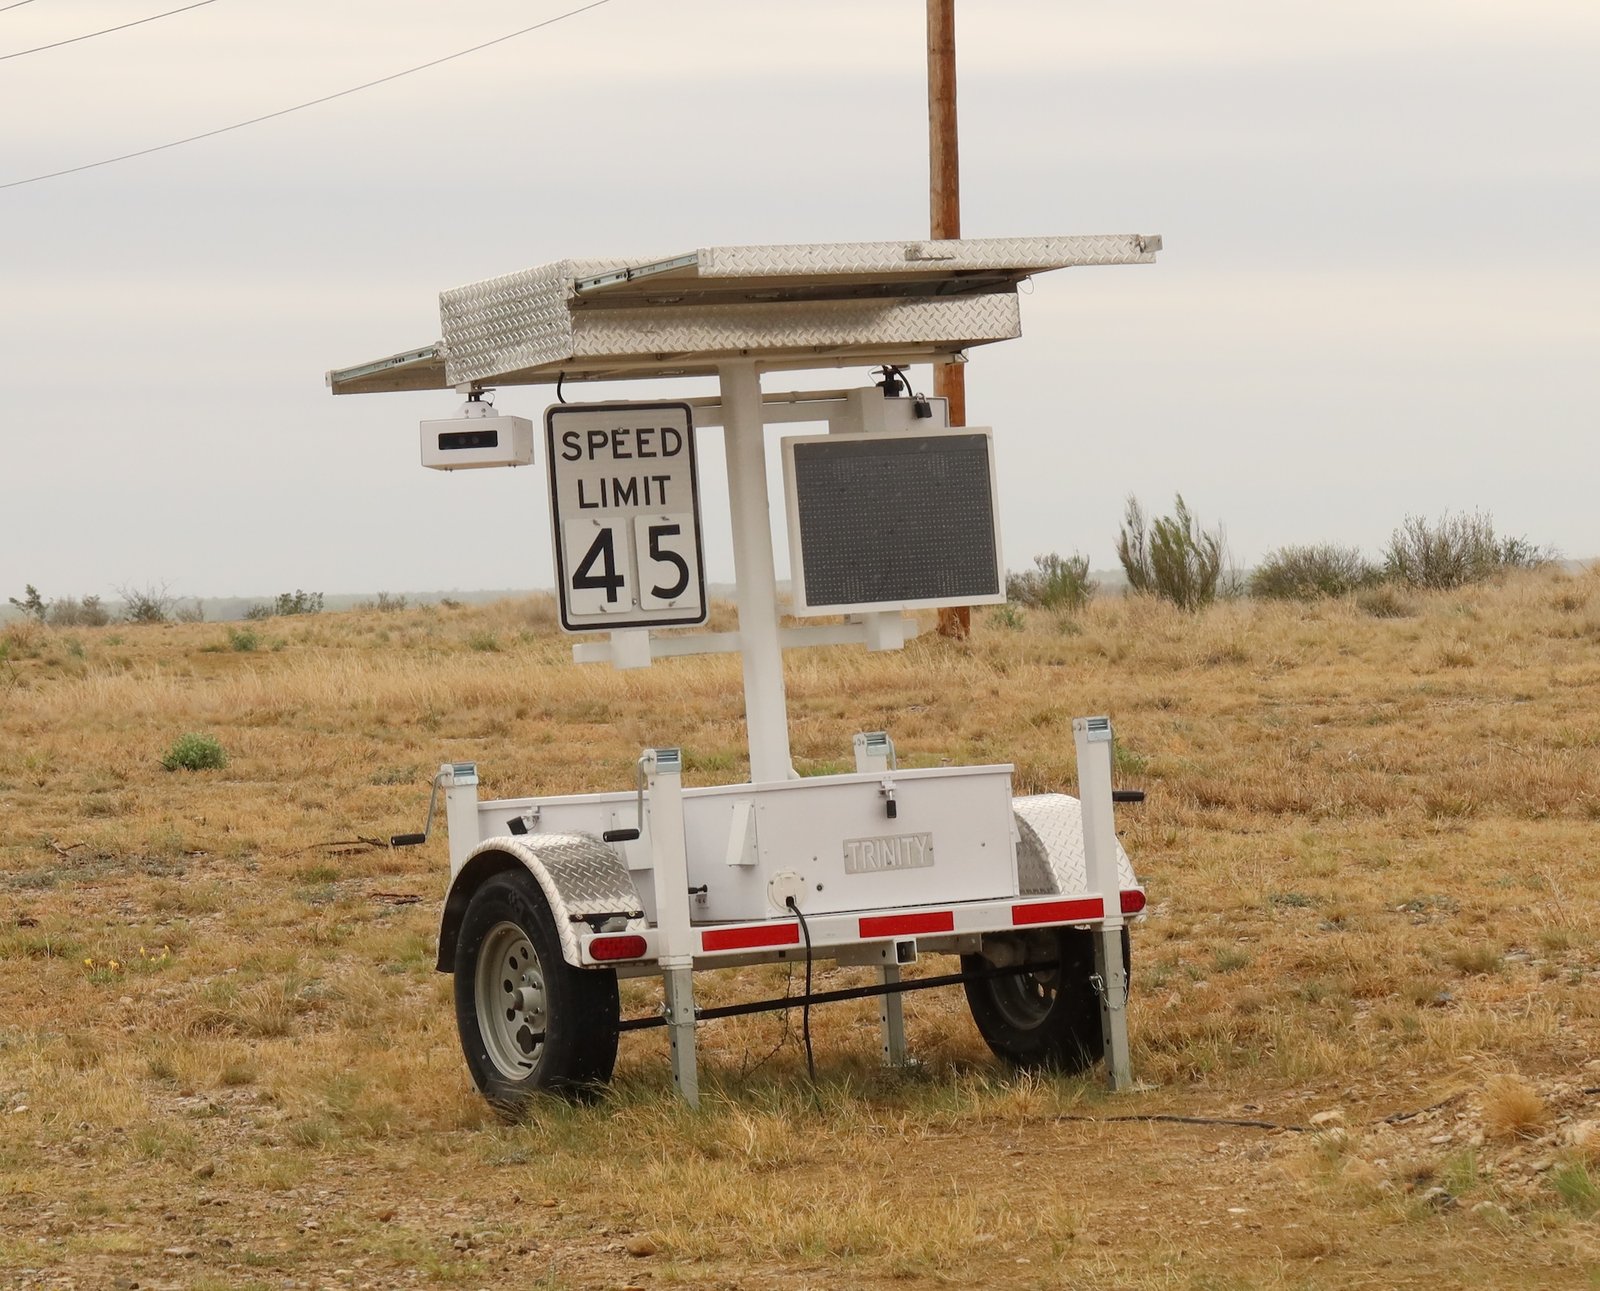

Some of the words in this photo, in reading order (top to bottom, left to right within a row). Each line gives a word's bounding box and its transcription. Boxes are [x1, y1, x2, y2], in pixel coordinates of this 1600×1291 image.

[562, 427, 682, 461] SPEED
[577, 475, 671, 509] LIMIT
[572, 524, 690, 603] 45
[847, 836, 929, 870] TRINITY
